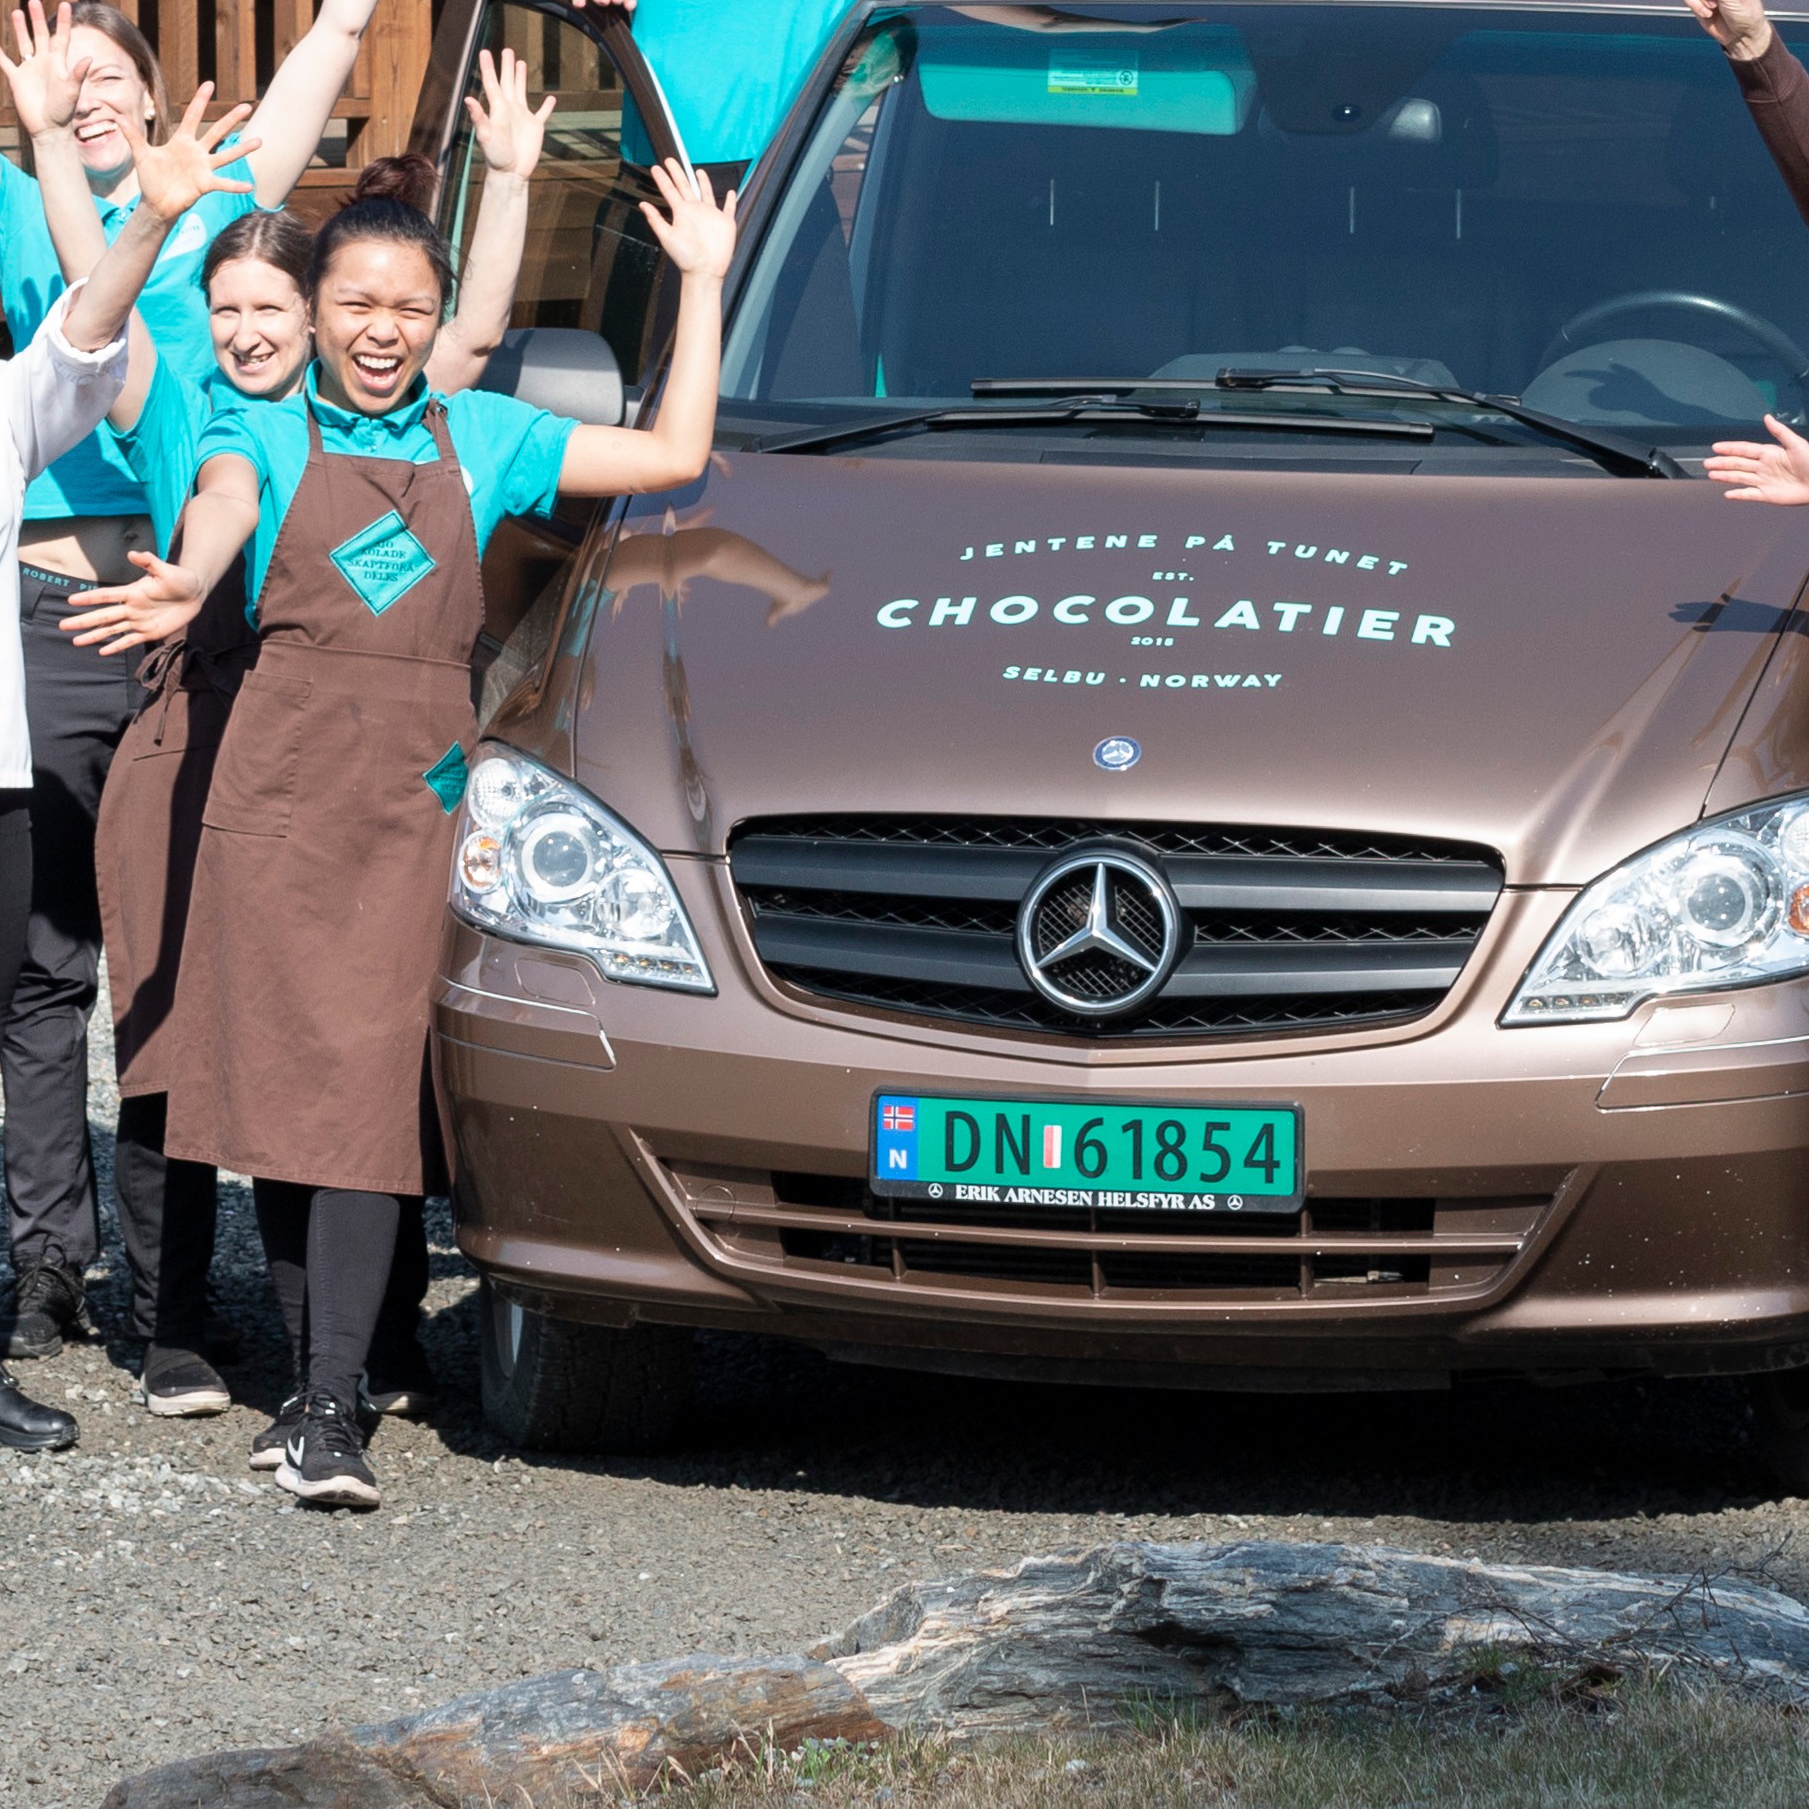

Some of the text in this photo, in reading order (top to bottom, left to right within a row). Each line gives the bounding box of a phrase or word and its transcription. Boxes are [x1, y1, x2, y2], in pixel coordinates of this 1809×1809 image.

[959, 534, 1408, 575] JENTENE PÅ TUNET
[22, 567, 70, 587] ROBERT
[1152, 571, 1194, 582] EST.
[876, 595, 1455, 647] CHOCOLATIER
[1002, 666, 1282, 688] SELBU NORWAY
[889, 1148, 907, 1169] N
[944, 1110, 1281, 1184] DN 61854
[955, 1184, 1216, 1210] ERIK ARNESEN HELSFYR AS
